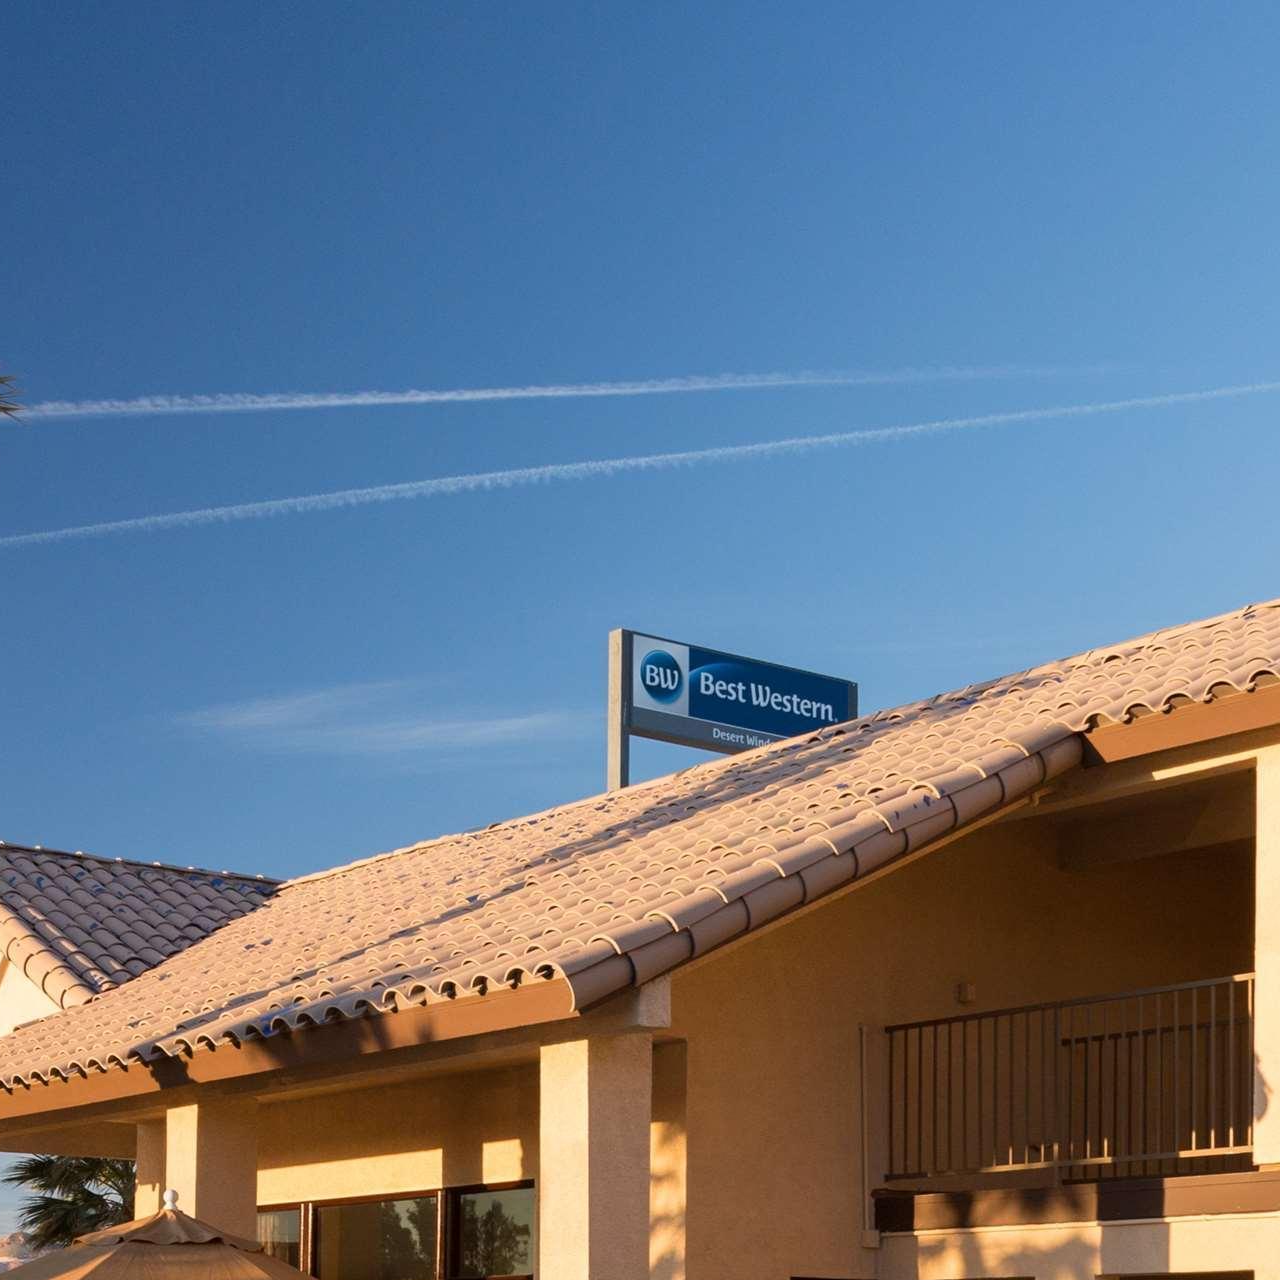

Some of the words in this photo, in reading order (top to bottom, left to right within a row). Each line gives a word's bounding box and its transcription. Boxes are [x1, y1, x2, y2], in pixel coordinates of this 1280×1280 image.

[645, 664, 679, 691] BW
[699, 671, 747, 703] Best
[750, 682, 834, 722] Western
[712, 727, 745, 744] Desert
